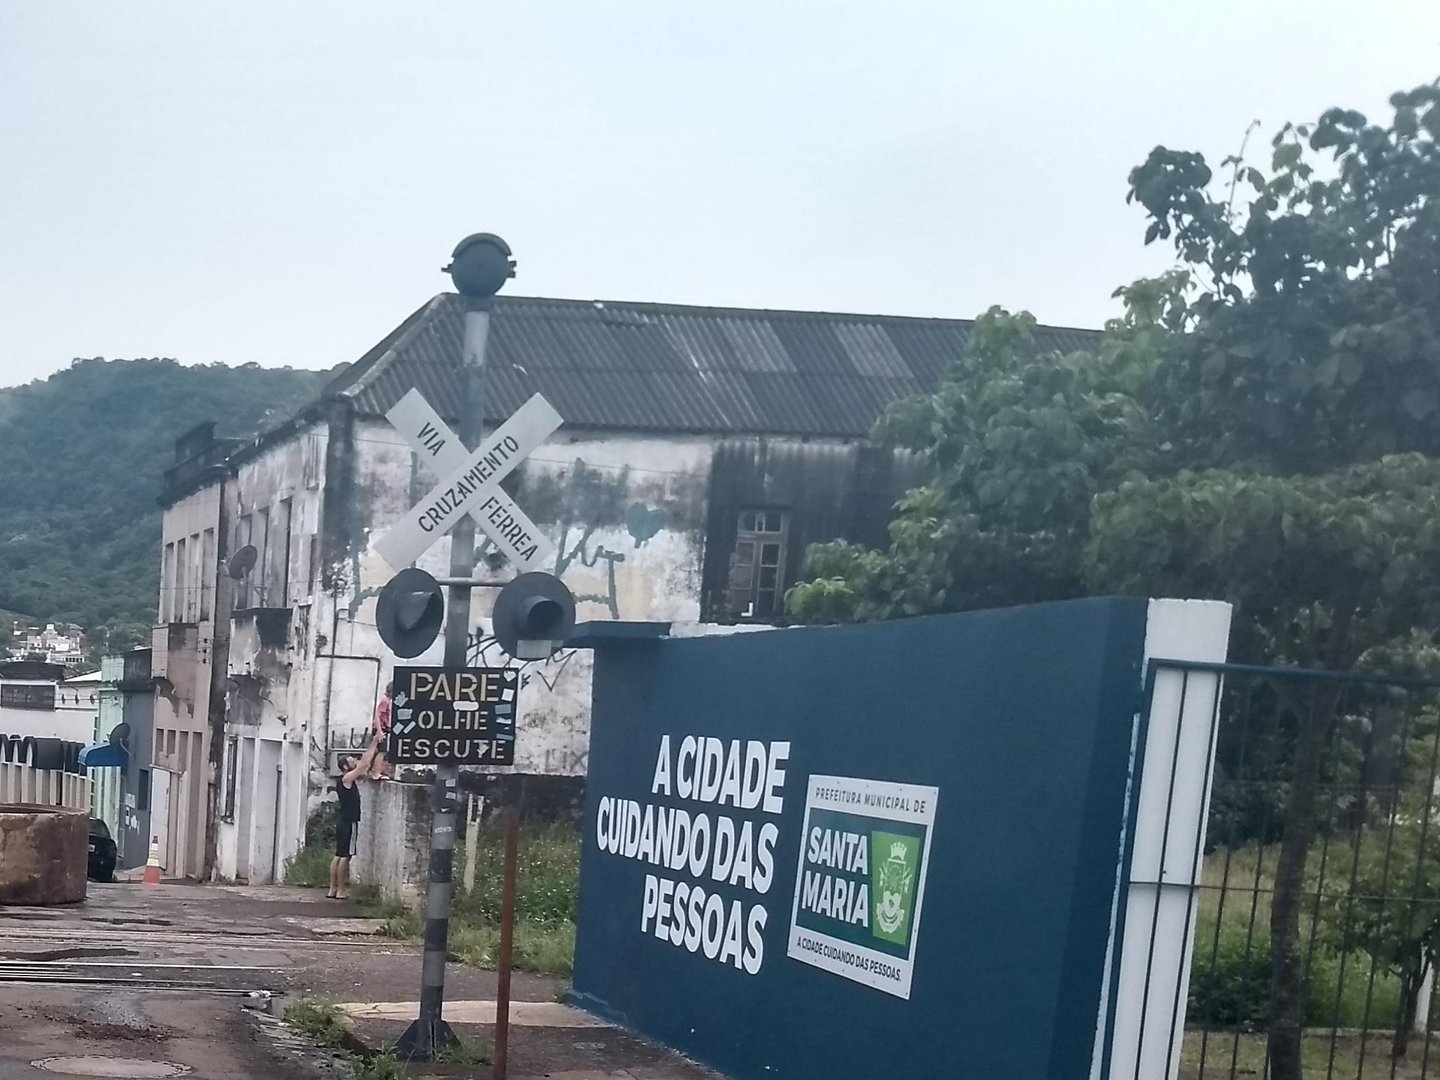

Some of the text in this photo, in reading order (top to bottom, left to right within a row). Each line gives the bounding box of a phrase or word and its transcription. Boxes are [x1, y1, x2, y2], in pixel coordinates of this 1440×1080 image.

[417, 422, 538, 561] VIA FÉRREA
[418, 435, 519, 532] CRUZAMENTO
[410, 672, 500, 701] PARE
[418, 710, 488, 730] OLHE
[397, 738, 506, 759] ESCUTE
[652, 735, 791, 814] A CIDADE
[815, 787, 926, 814] PREFEITURA MUNICIPAL DE
[596, 796, 779, 894] CUIDANDO DAS
[807, 826, 868, 875] SANTA
[640, 874, 768, 975] PESSOAS
[801, 870, 869, 928] MARIA
[796, 936, 801, 948] A
[802, 938, 823, 955] CIDADE
[823, 945, 855, 966] CUIDANDO
[855, 955, 869, 971] DAS
